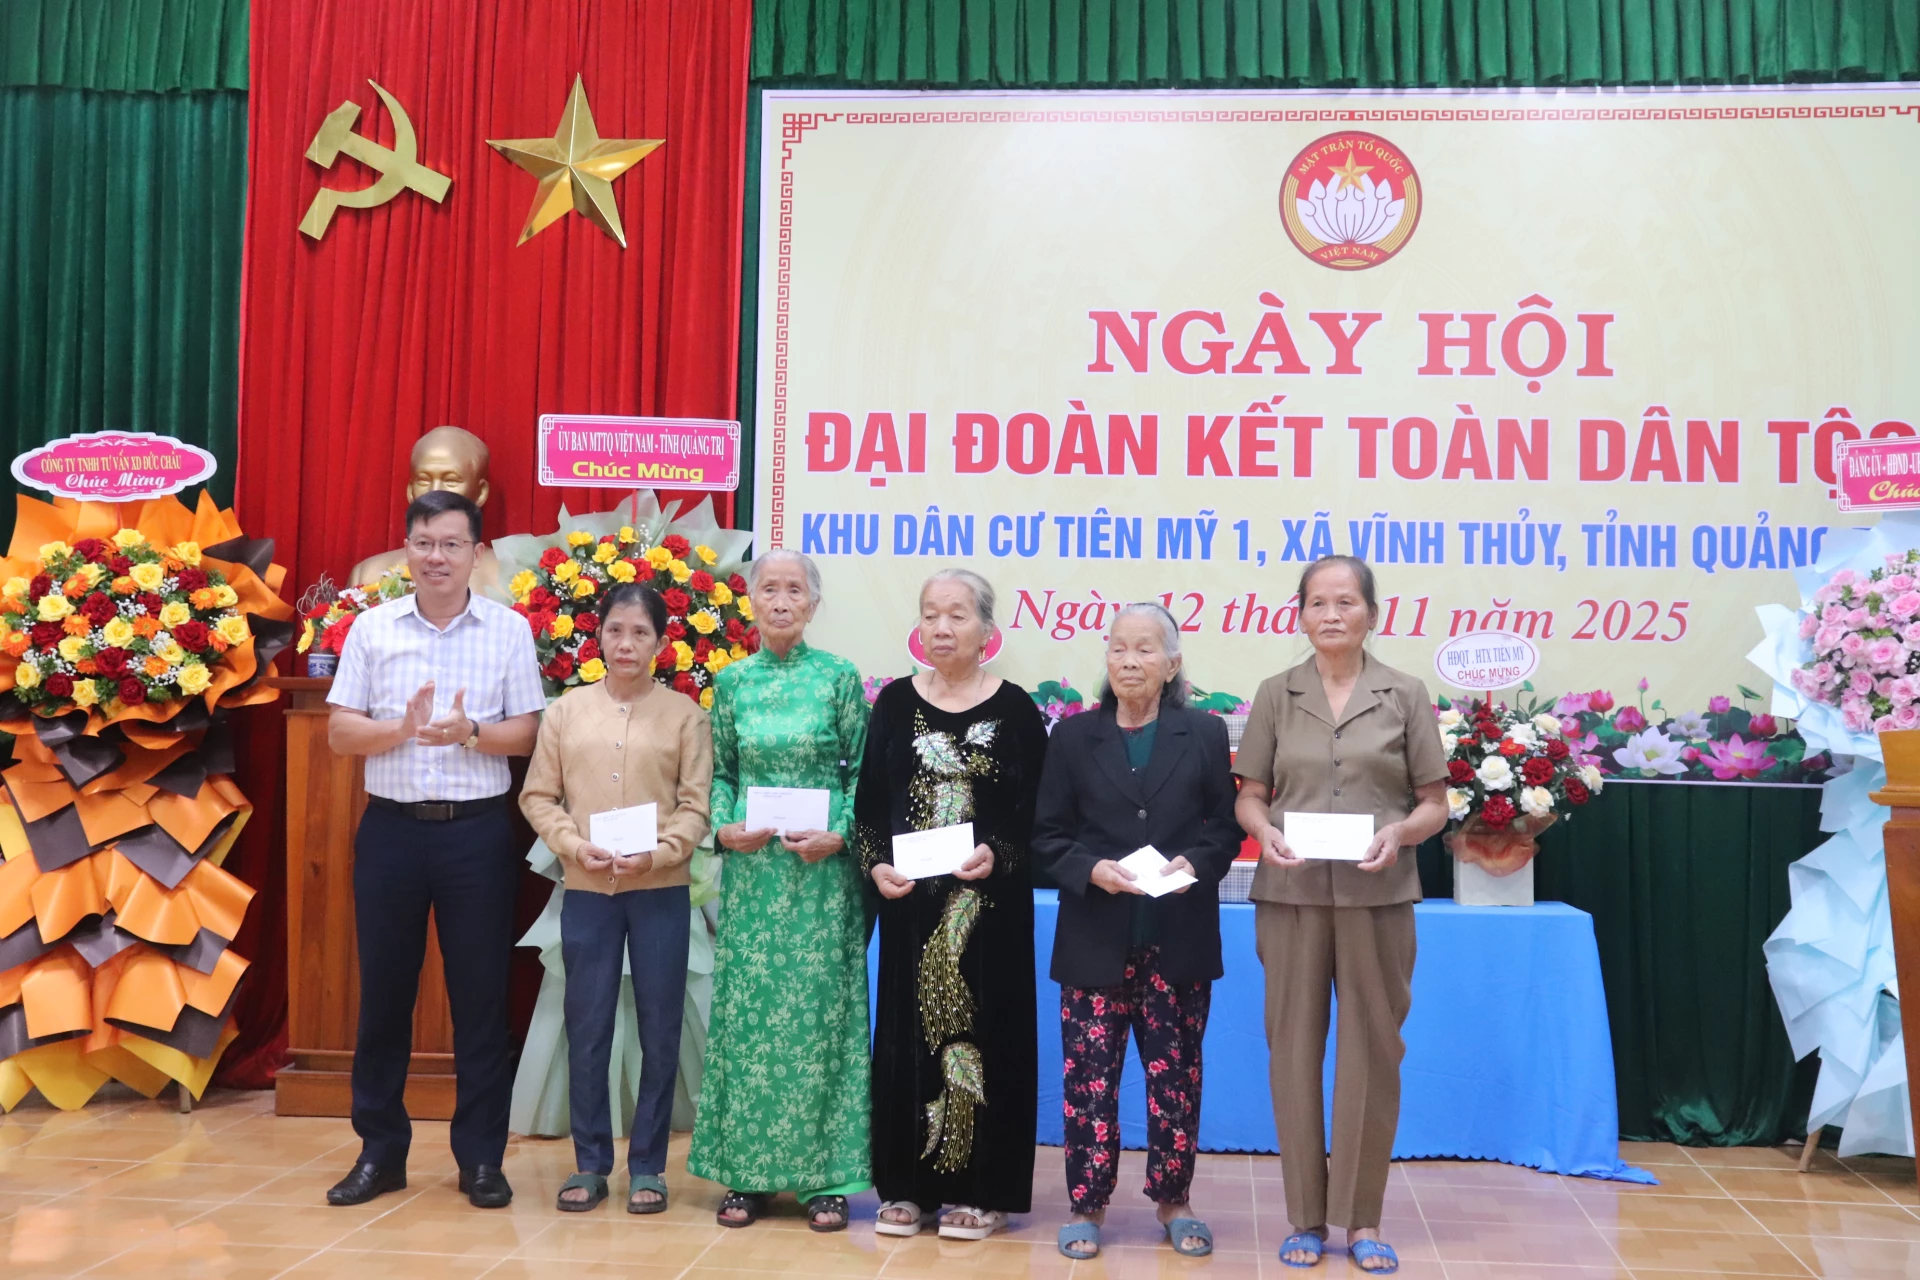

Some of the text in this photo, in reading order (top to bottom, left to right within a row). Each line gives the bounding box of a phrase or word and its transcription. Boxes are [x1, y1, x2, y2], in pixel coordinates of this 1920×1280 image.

[1298, 139, 1404, 175] MẶT TRẬN TỔ QUỐC
[1320, 246, 1379, 260] VIỆT NAM
[1087, 292, 1614, 394] NGÀY HỘI
[558, 425, 571, 450] ỦY
[571, 432, 588, 450] BAN
[589, 432, 613, 456] MTTQ
[615, 430, 634, 457] VIỆT
[635, 433, 654, 453] NAM
[660, 428, 679, 454] TỈNH
[681, 429, 710, 458] QUẢNG
[711, 436, 725, 460] TRỊ
[805, 395, 1916, 499] ĐẠI ĐOÀN KẾT TOÀN DÂN TỘ
[41, 449, 181, 473] CÔNG TY TNHH TƯ VẤN XD ĐỨC CHÂU
[572, 461, 704, 483] Chúc Mừng
[1849, 450, 1870, 478] ĐẢNG
[65, 472, 166, 488] Chúc Mừng
[802, 513, 879, 555] KHU
[893, 506, 974, 557] DÂN
[988, 511, 1045, 558] CƯ
[1054, 508, 1141, 559] TIÊN
[1157, 510, 1218, 561] MỸ
[1232, 519, 1267, 567] 1,
[1281, 511, 1334, 562] XÃ
[1348, 512, 1444, 564] VĨNH
[1458, 508, 1567, 571] THỦY,
[1582, 509, 1676, 568] TỈNH
[1221, 593, 1300, 635] thá
[1376, 596, 1430, 637] 11
[1449, 598, 1554, 639] năm
[1571, 599, 1690, 642] 2025
[1475, 648, 1492, 664] HTX
[1457, 665, 1520, 680] CHÚC MỪNG
